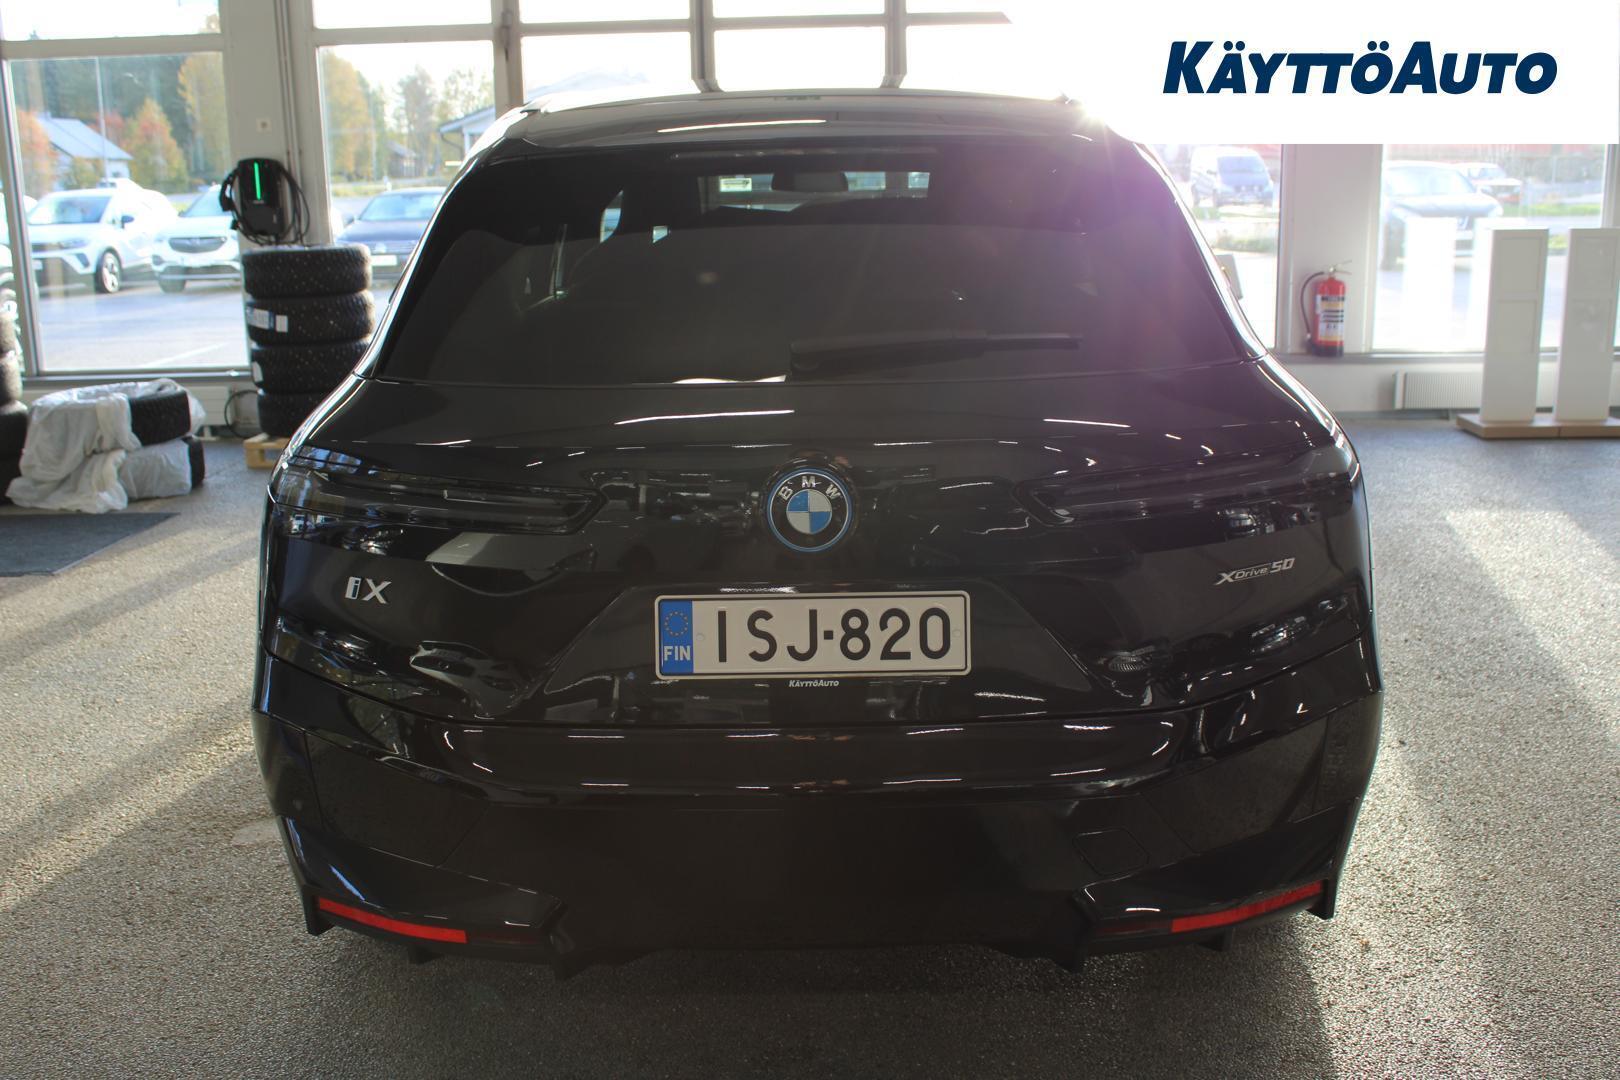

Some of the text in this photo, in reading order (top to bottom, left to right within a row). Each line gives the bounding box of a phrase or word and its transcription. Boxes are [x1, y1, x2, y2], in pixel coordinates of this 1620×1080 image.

[779, 475, 841, 500] BMW
[717, 607, 952, 663] ISJ-820
[663, 645, 691, 661] FIN
